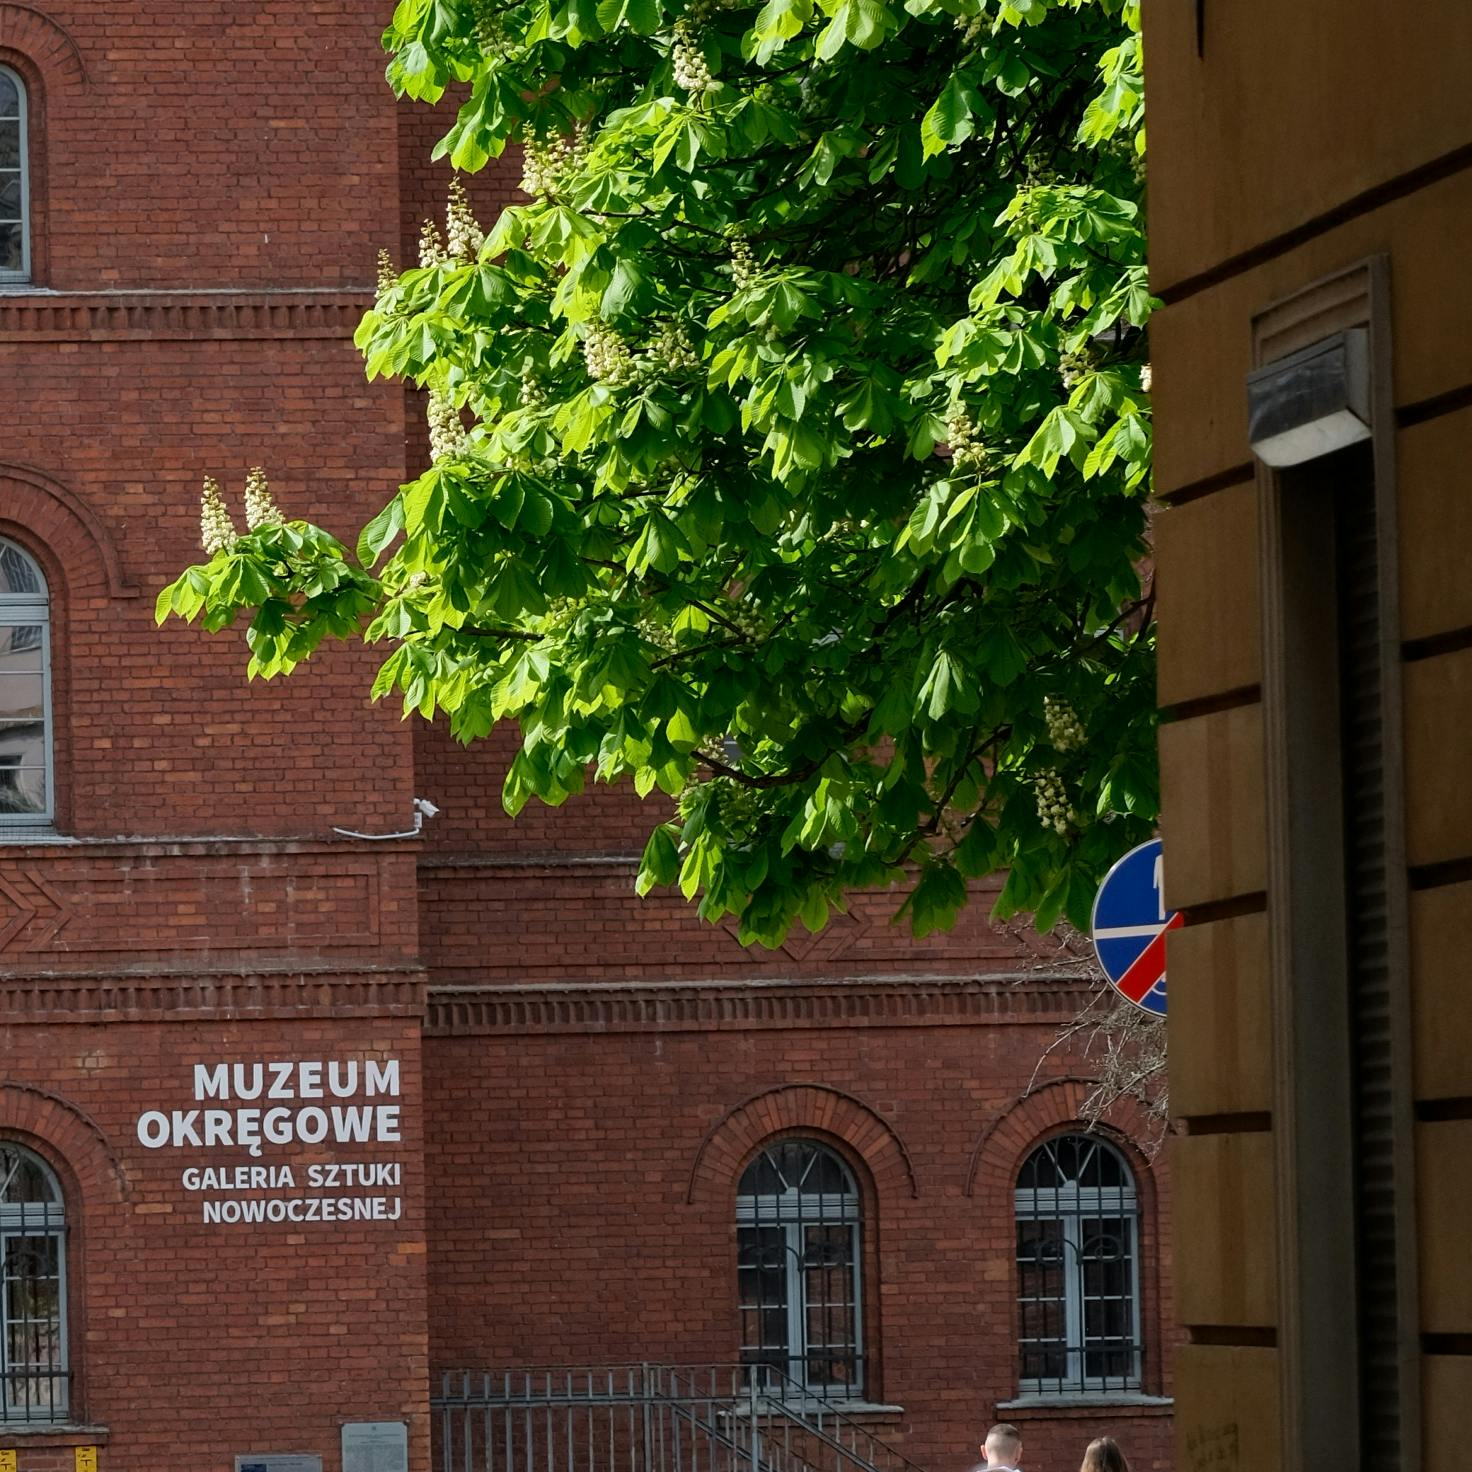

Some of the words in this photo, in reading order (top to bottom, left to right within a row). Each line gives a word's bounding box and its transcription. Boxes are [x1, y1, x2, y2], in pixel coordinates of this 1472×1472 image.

[195, 1060, 399, 1100] MUZEUM
[138, 1106, 400, 1156] OKRĘGOWE
[183, 1166, 295, 1190] GALERIA
[308, 1164, 400, 1187] SZTUKI
[204, 1198, 401, 1223] NOWOCZESNEJ
